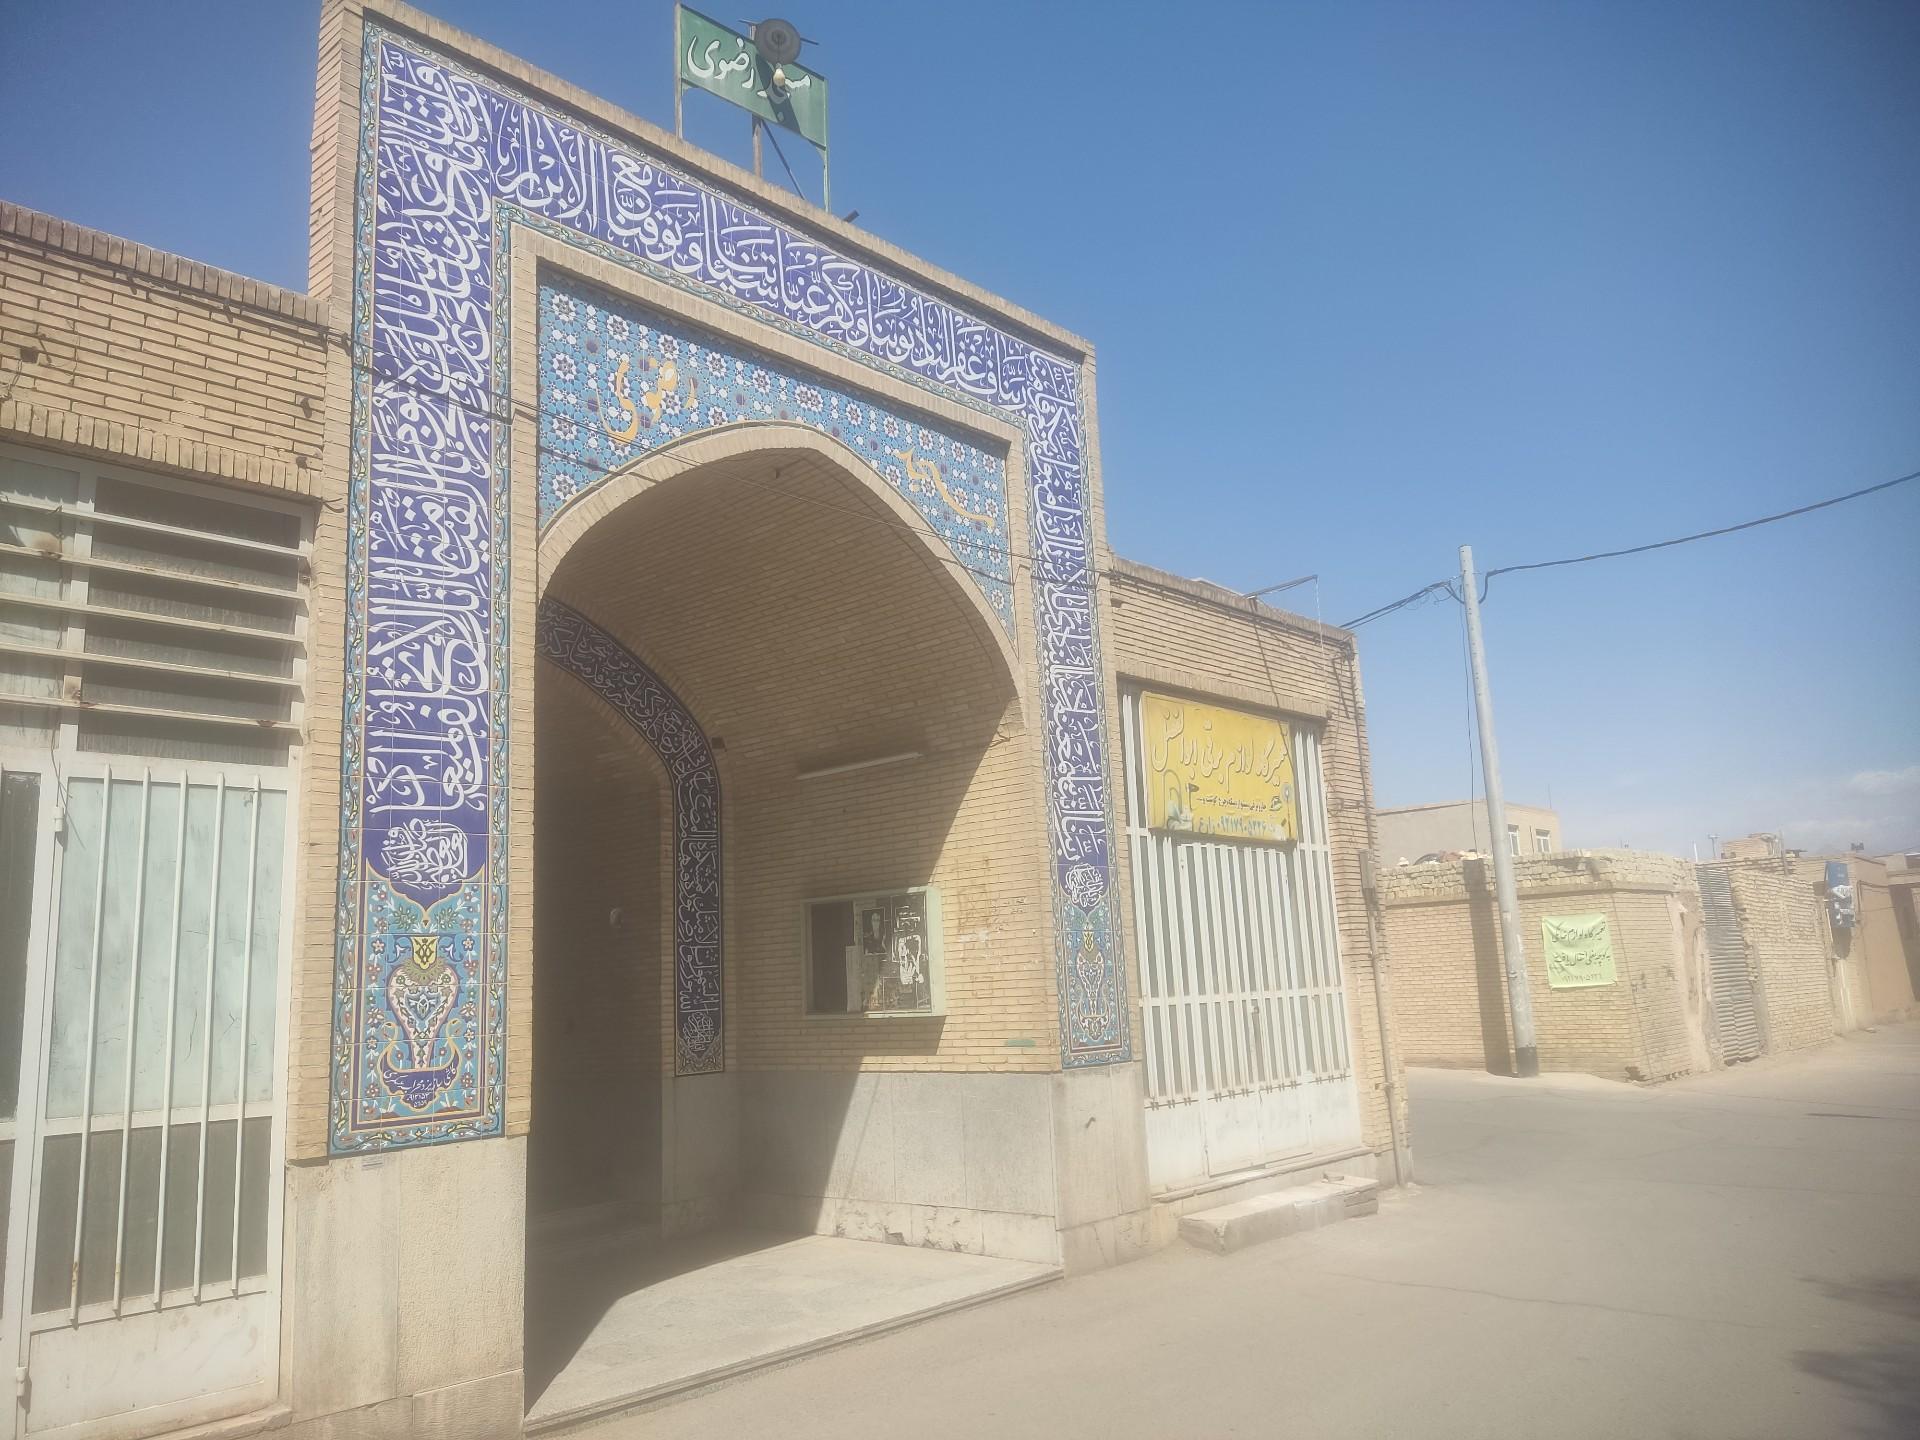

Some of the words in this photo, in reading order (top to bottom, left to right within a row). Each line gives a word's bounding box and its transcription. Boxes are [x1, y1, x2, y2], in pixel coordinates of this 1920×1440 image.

[687, 36, 755, 90] رضوی
[596, 357, 698, 445] رضوی
[891, 446, 996, 530] مسجد
